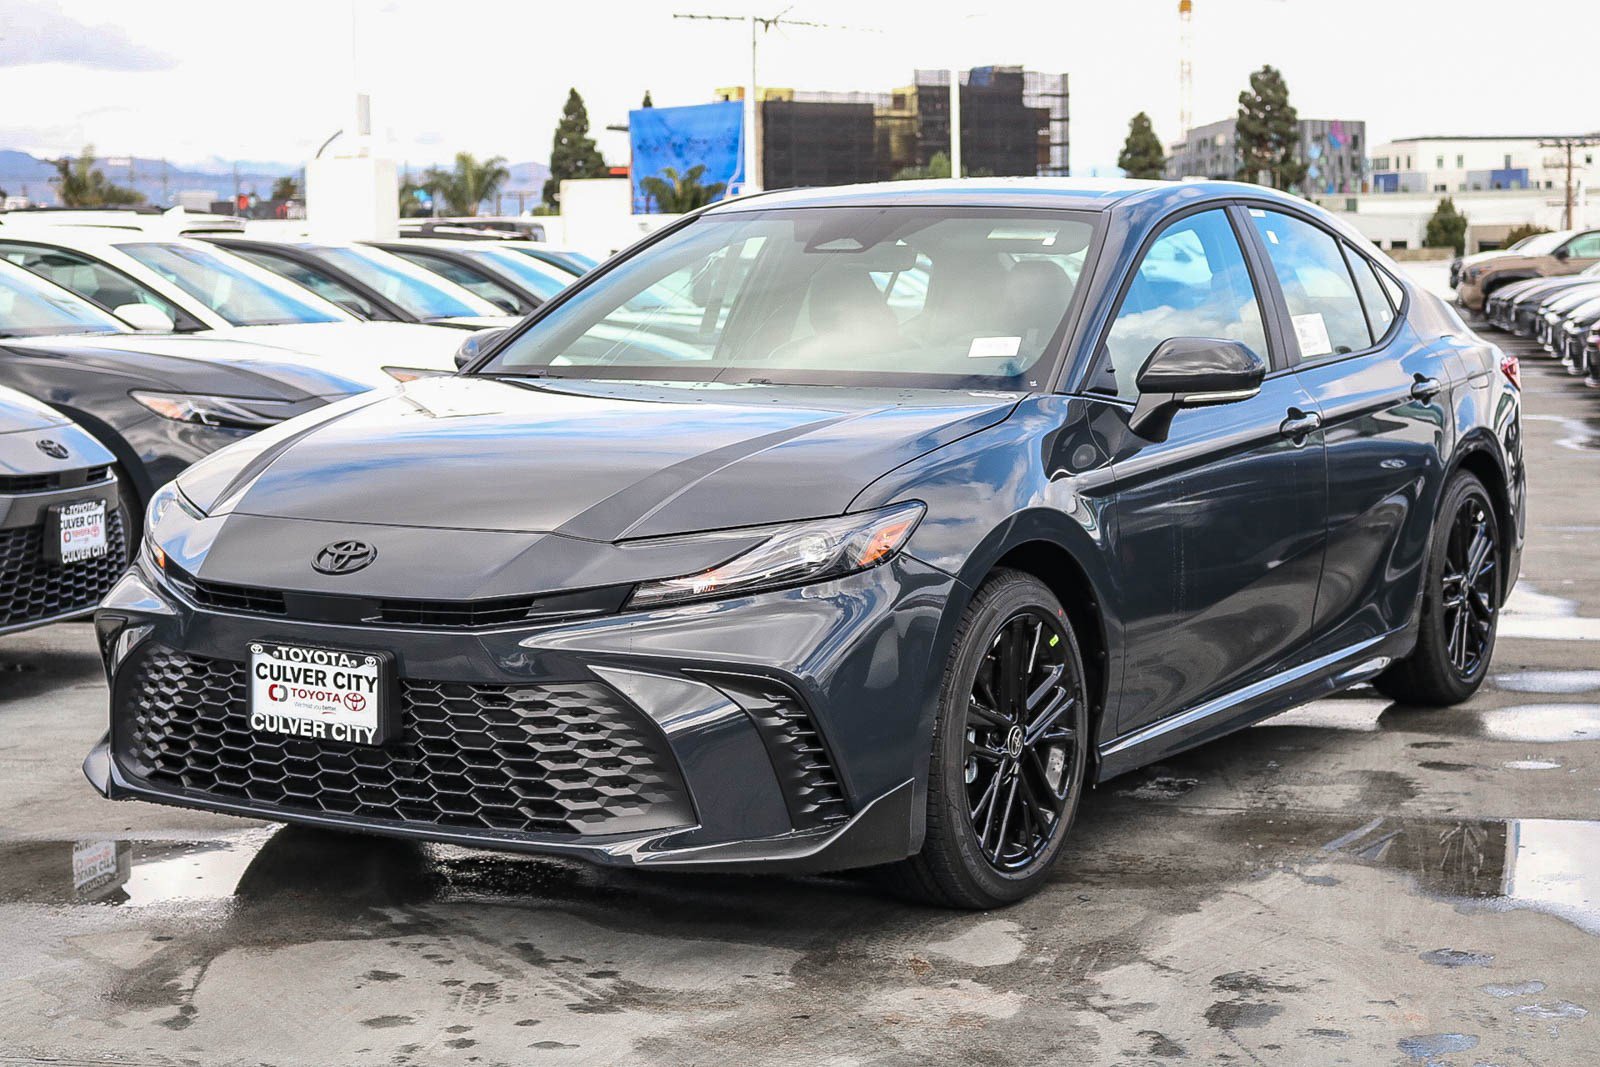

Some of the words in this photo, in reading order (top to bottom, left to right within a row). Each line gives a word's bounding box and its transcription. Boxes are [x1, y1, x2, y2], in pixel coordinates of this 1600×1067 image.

[87, 513, 104, 526] CITY
[62, 549, 91, 564] CULVER
[92, 542, 108, 557] CITY
[277, 646, 352, 668] TOYOTA
[255, 662, 327, 687] CULVER
[333, 672, 378, 693] CITY
[291, 687, 341, 704] TOYOTA
[250, 712, 326, 738] CULVER
[331, 723, 377, 744] CITY
